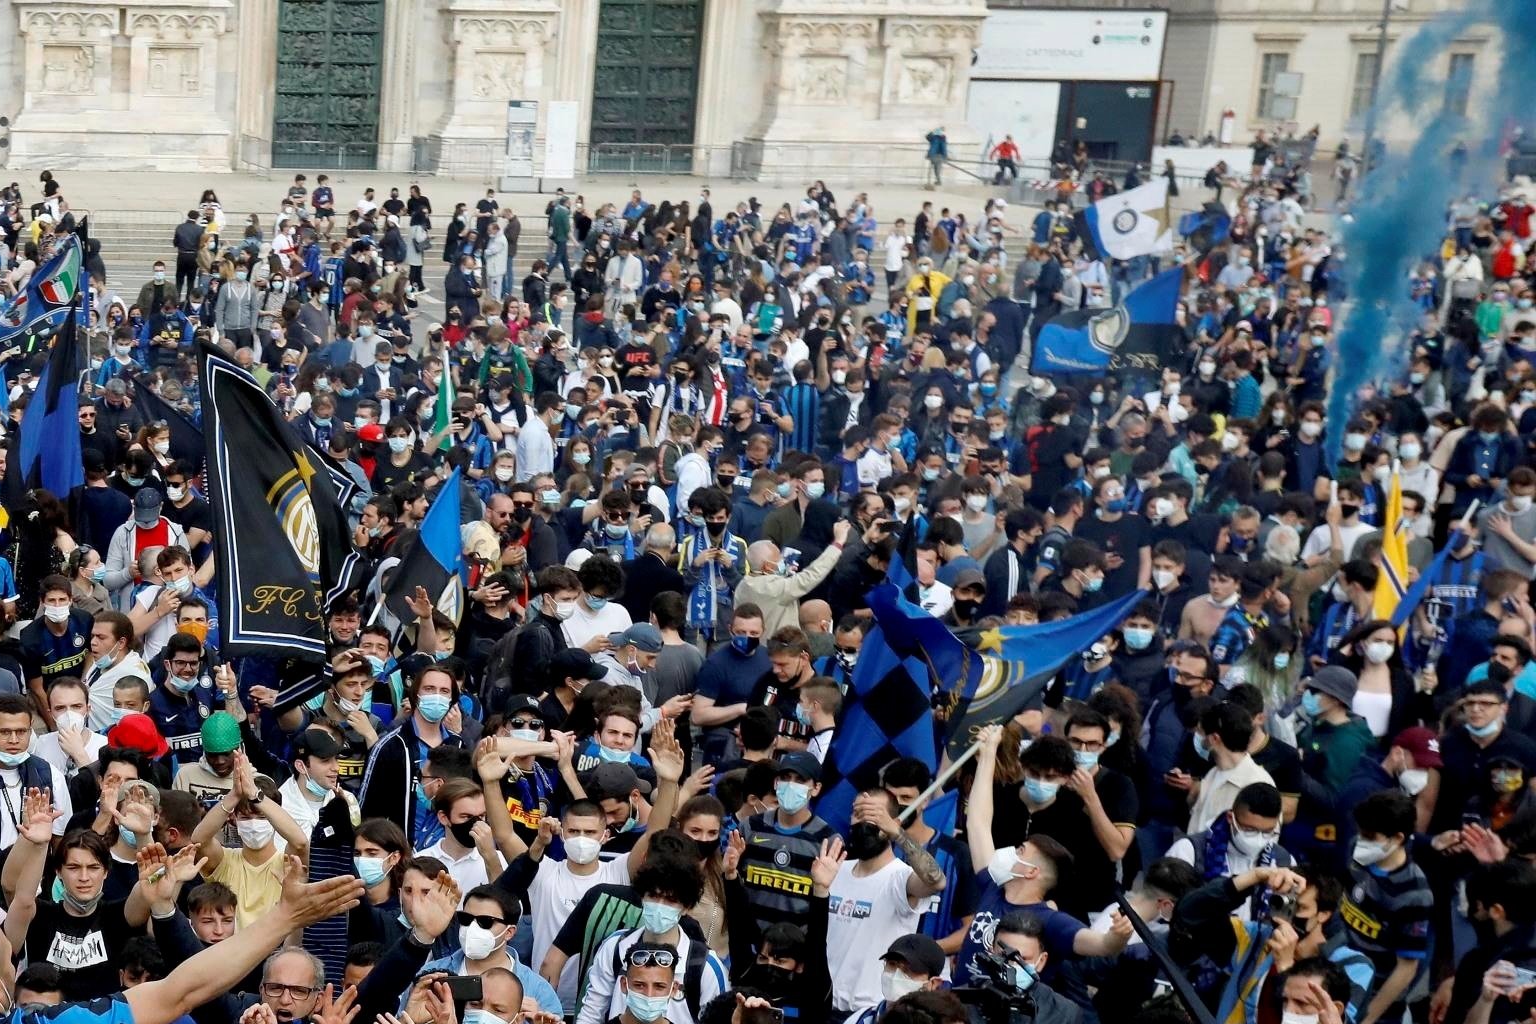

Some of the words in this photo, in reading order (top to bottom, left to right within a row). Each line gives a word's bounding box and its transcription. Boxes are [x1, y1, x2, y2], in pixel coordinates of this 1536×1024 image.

[626, 352, 650, 364] UFC
[746, 864, 813, 896] PIRELLI
[51, 937, 103, 966] ARMANI
